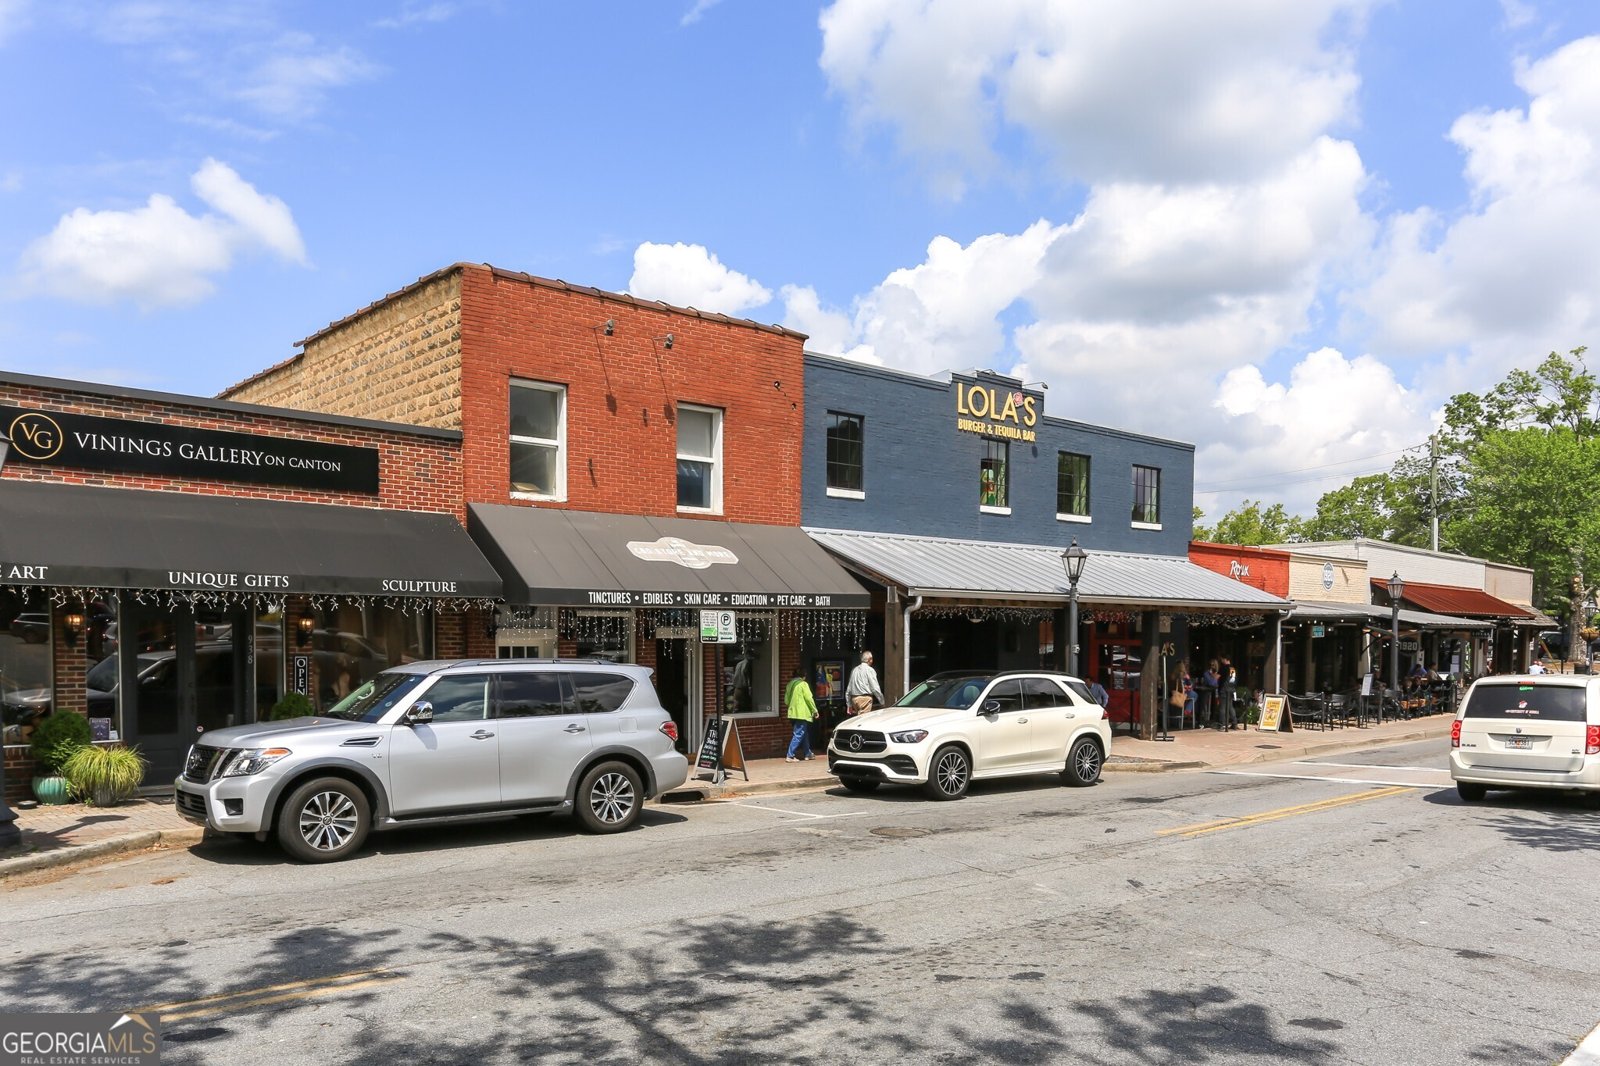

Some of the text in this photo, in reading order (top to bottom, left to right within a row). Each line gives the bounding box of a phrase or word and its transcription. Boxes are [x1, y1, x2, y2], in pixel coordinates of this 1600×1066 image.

[19, 422, 53, 449] VG
[957, 418, 1036, 442] BURGER & TEQUILA BAR
[73, 431, 341, 472] VININGS GALLERY ON CANTON
[8, 565, 49, 579] ART
[168, 571, 289, 588] UNIQUE GIFTS
[382, 579, 457, 593] SCULPTURE
[588, 591, 831, 606] TINCTURES EDIBLES SKIN CARE EDUCATION PET CARE BATH
[296, 658, 306, 696] OPEN
